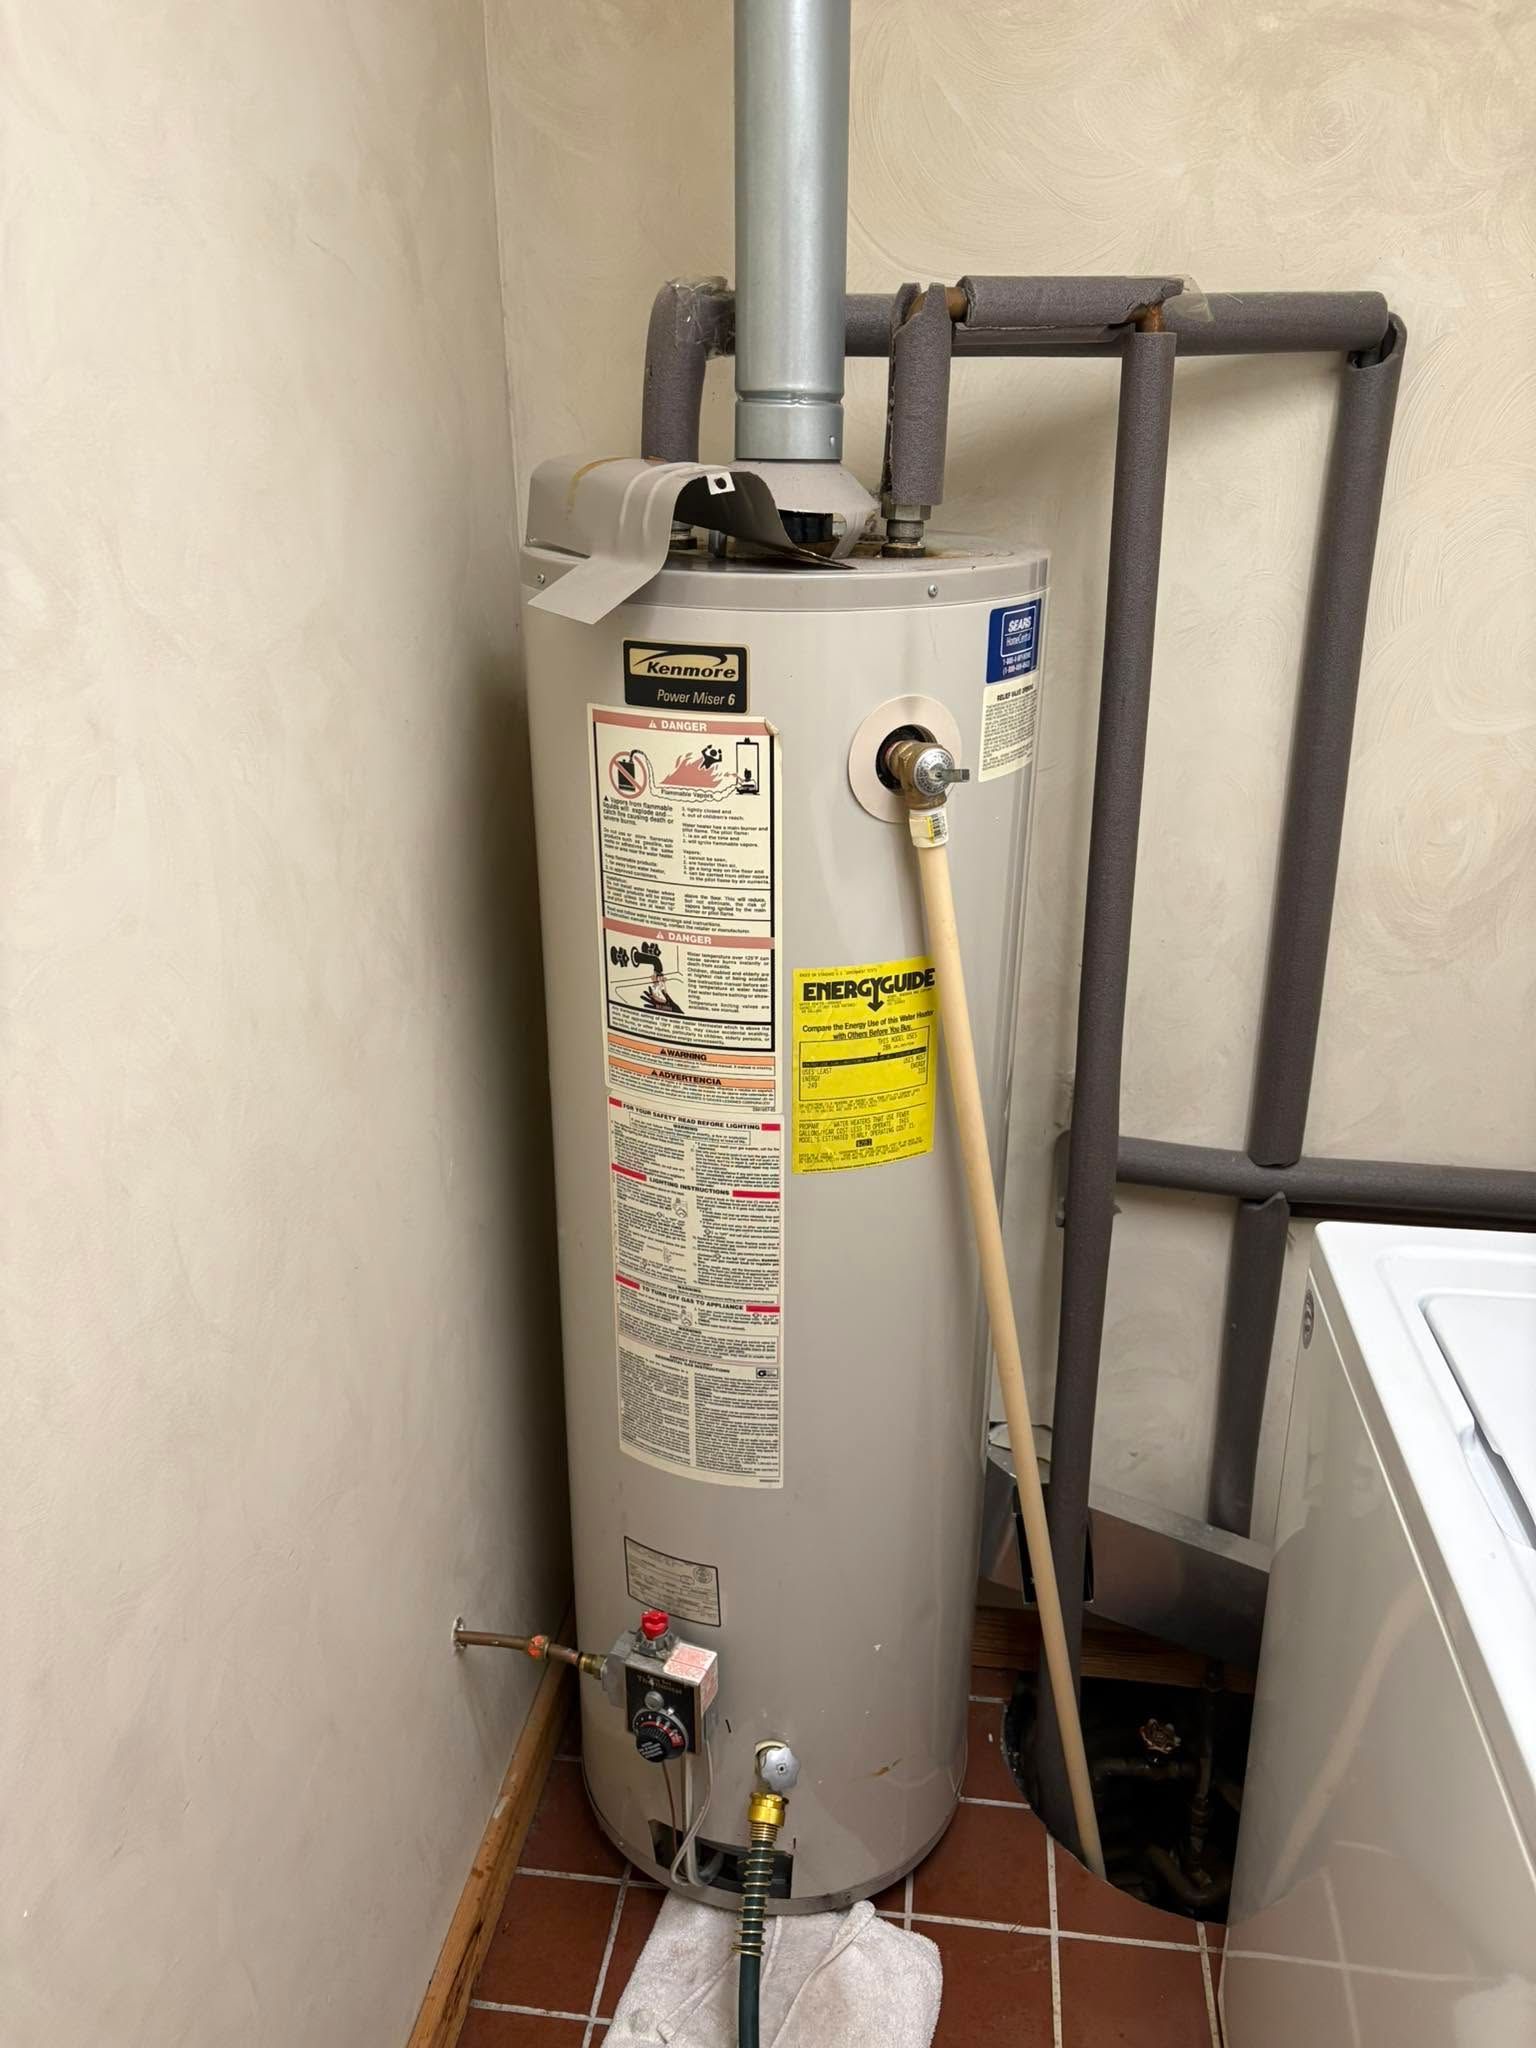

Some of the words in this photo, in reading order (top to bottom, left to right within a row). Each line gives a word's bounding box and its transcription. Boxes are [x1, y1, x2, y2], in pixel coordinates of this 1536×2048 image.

[1008, 618, 1031, 632] SEARS
[647, 662, 736, 679] Kenmore
[657, 689, 690, 703] Power
[693, 692, 725, 706] Miser
[728, 694, 736, 706] 6
[661, 720, 707, 732] DANGER
[661, 789, 691, 797] Flammable
[668, 932, 712, 945] DANGER
[803, 968, 936, 1008] ENERGYGUIDE
[803, 1024, 832, 1034] Compare
[845, 1021, 867, 1031] Energy
[868, 1019, 879, 1027] Use
[880, 1018, 887, 1026] of
[888, 1016, 899, 1024] this
[900, 1014, 916, 1022] Water
[917, 1010, 934, 1020] Heater
[833, 1033, 847, 1041] with
[848, 1031, 868, 1040] Others
[869, 1028, 888, 1036] Before
[668, 1050, 707, 1061] WARNING
[659, 1071, 722, 1086] ADVERTENCIA
[636, 1108, 652, 1116] YOUR
[653, 1112, 677, 1121] SAFETY
[698, 1120, 724, 1128] BEFORE
[649, 1177, 679, 1188] LIGHTING
[680, 1184, 730, 1196] INSTRUCTIONS
[651, 1289, 667, 1298] TURN
[707, 1302, 744, 1310] APPLIANCE
